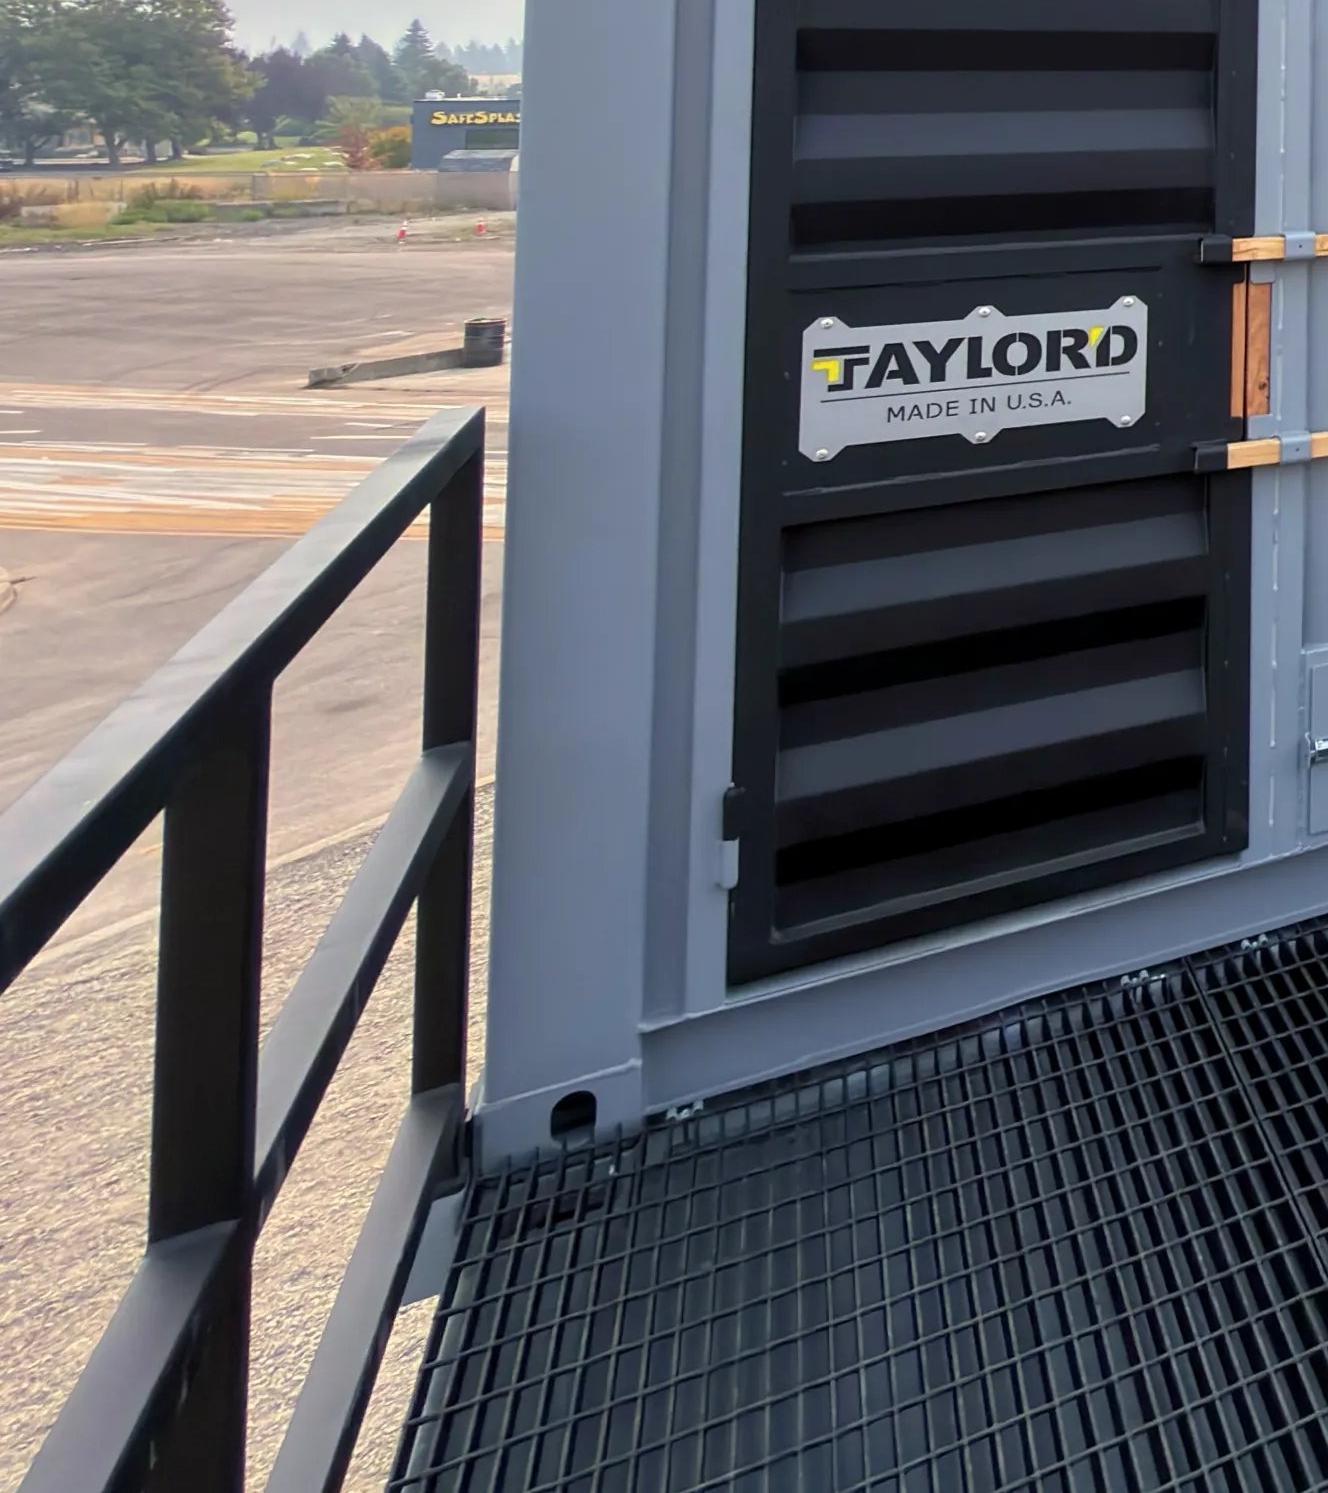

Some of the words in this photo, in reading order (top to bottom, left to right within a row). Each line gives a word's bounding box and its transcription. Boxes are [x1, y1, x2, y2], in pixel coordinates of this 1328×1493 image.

[887, 401, 960, 423] MADE
[969, 398, 996, 415] IN
[1006, 389, 1072, 410] U.S.A.
